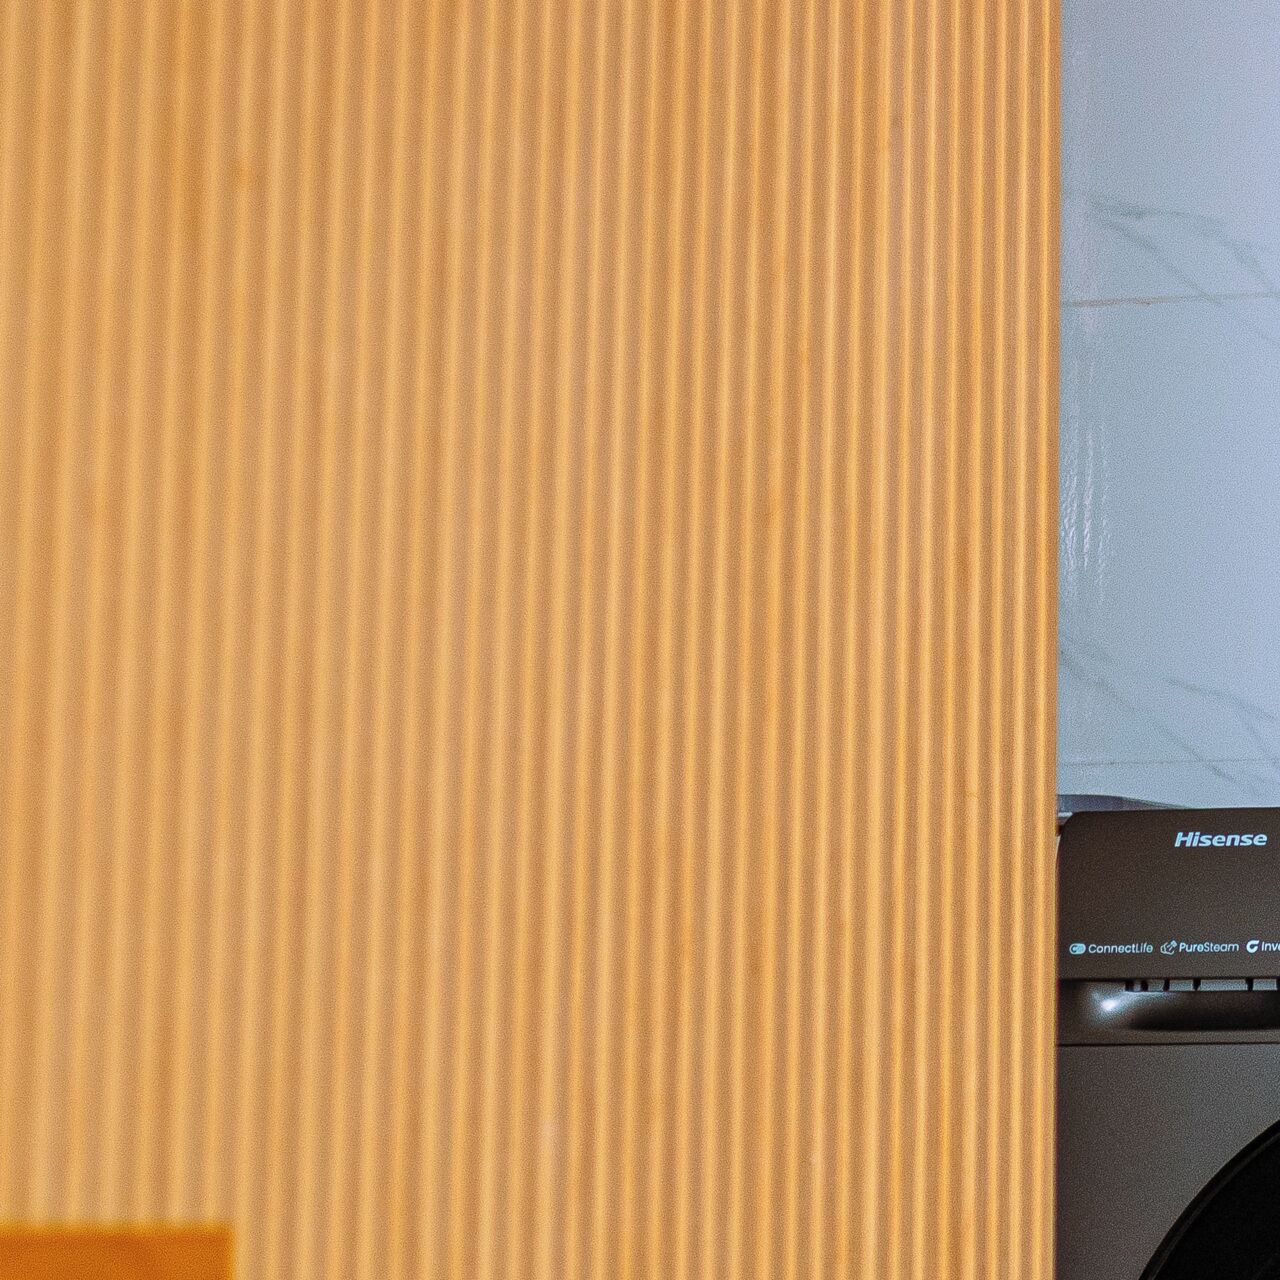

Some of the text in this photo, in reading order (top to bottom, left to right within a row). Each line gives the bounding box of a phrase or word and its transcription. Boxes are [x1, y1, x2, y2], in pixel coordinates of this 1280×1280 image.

[1174, 831, 1268, 848] Hisense
[1088, 942, 1153, 955] ConnectLife
[1179, 941, 1240, 953] PureSteam
